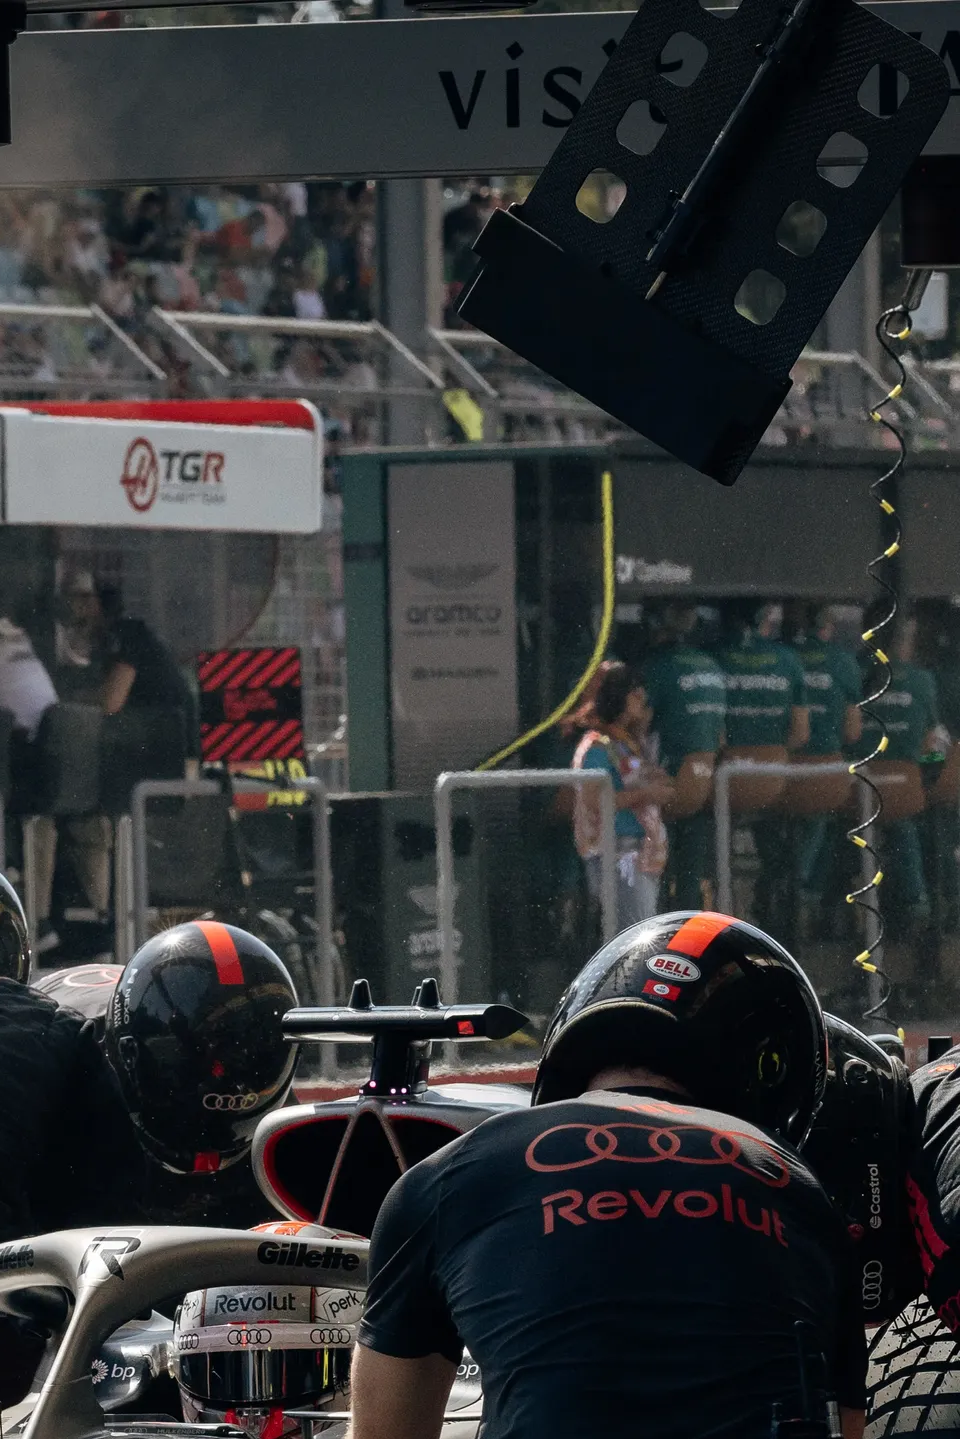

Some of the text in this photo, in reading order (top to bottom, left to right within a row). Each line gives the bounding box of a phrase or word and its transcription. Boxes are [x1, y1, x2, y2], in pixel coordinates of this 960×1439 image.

[160, 451, 225, 483] TGR
[654, 958, 691, 977] BELL
[124, 988, 132, 1025] NEXO
[868, 1163, 879, 1215] Castrol
[541, 1183, 788, 1248] Revolut
[257, 1241, 361, 1273] Gillette
[214, 1292, 297, 1315] Revolut
[328, 1290, 361, 1319] perk
[111, 1363, 136, 1381] bp
